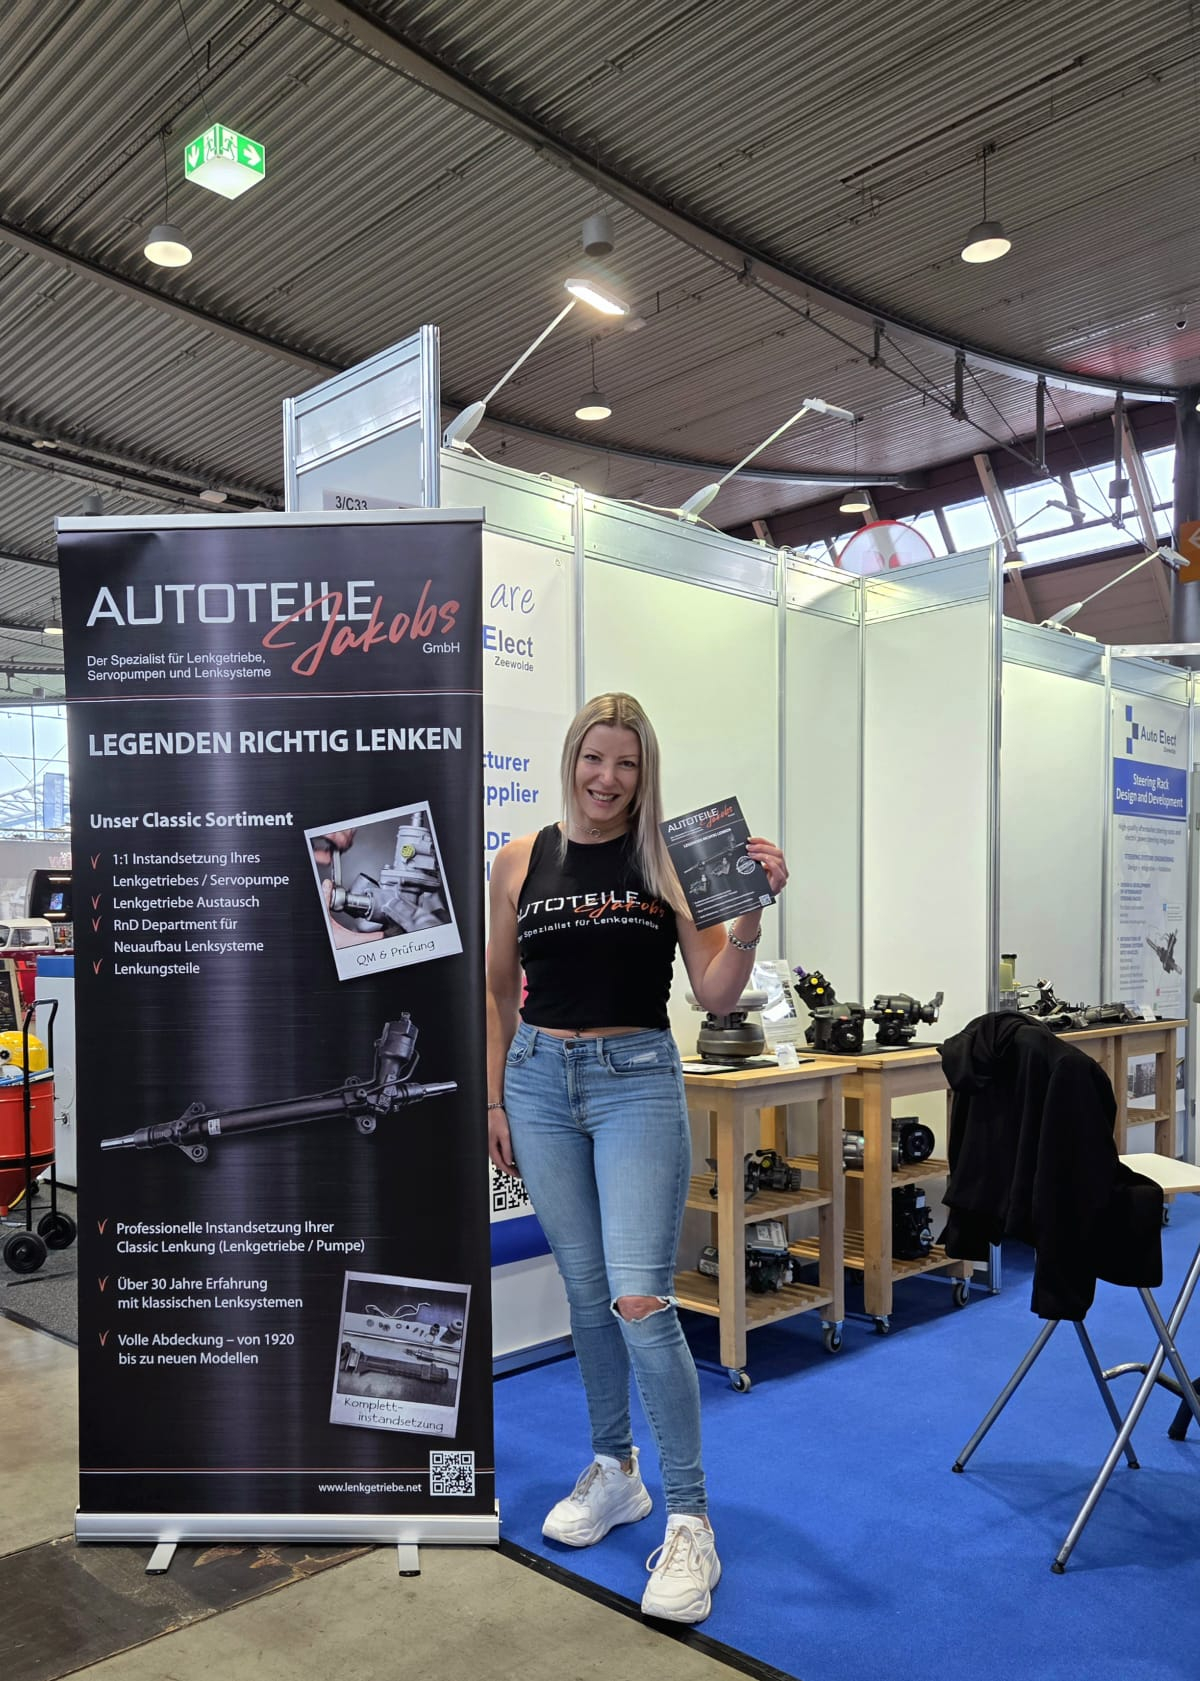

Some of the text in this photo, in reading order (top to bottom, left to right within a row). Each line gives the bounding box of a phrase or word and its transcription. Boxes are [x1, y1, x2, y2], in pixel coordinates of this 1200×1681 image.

[335, 495, 368, 511] 3/C33
[86, 580, 376, 627] AUTOTEILE
[490, 583, 535, 614] are
[261, 579, 460, 677] Jakobs
[422, 641, 460, 654] GmbH
[483, 624, 534, 658] Elect
[87, 651, 266, 668] Der Spezialist für Lenkgetriebe,
[494, 656, 534, 672] Zeewolde
[87, 666, 271, 683] Servopumpen und Lenksysteme
[89, 727, 462, 757] LEGENDEN RICHTIG LENKEN
[1140, 726, 1177, 747] Auto Elect
[483, 750, 530, 772] turer
[1132, 773, 1169, 791] Steering Rack
[484, 781, 539, 807] pplier
[1116, 788, 1184, 809] Design and Development
[90, 811, 294, 829] Unser Classic Sortiment
[668, 807, 719, 833] AUTOTEILE
[112, 852, 261, 868] 1:1 Instandsetzung Ihres
[112, 874, 199, 890] Lenkgetriebes
[210, 873, 289, 889] Servopumpe
[113, 895, 260, 911] Lenkgetriebe Austausch
[517, 891, 641, 924] UTOTEILE
[113, 917, 238, 934] RnD Department für
[575, 919, 591, 927] für
[114, 939, 264, 955] Neuaufbau Lenksysteme
[356, 938, 435, 968] QM & Prüfung
[114, 962, 200, 979] Lenkungsteile
[116, 1221, 334, 1237] Professionelle Instandsetzung Ihrer
[116, 1240, 159, 1254] Classic
[161, 1240, 216, 1256] Lenkung
[218, 1240, 306, 1256] (Lenkgetriebe
[316, 1239, 365, 1254] Pumpe)
[117, 1276, 268, 1292] Über 30 Jahre Erfahrung
[118, 1296, 303, 1311] mit klassischen Lenksystemen
[118, 1333, 149, 1346] Volle
[151, 1333, 224, 1349] Abdeckung
[237, 1335, 261, 1346] von
[264, 1333, 295, 1346] 1920
[118, 1352, 259, 1365] bis zu neuen Modellen
[343, 1397, 404, 1413] Komplett-
[358, 1413, 444, 1433] instandsetzung
[318, 1481, 422, 1495] www.lenkgetriebe.net
